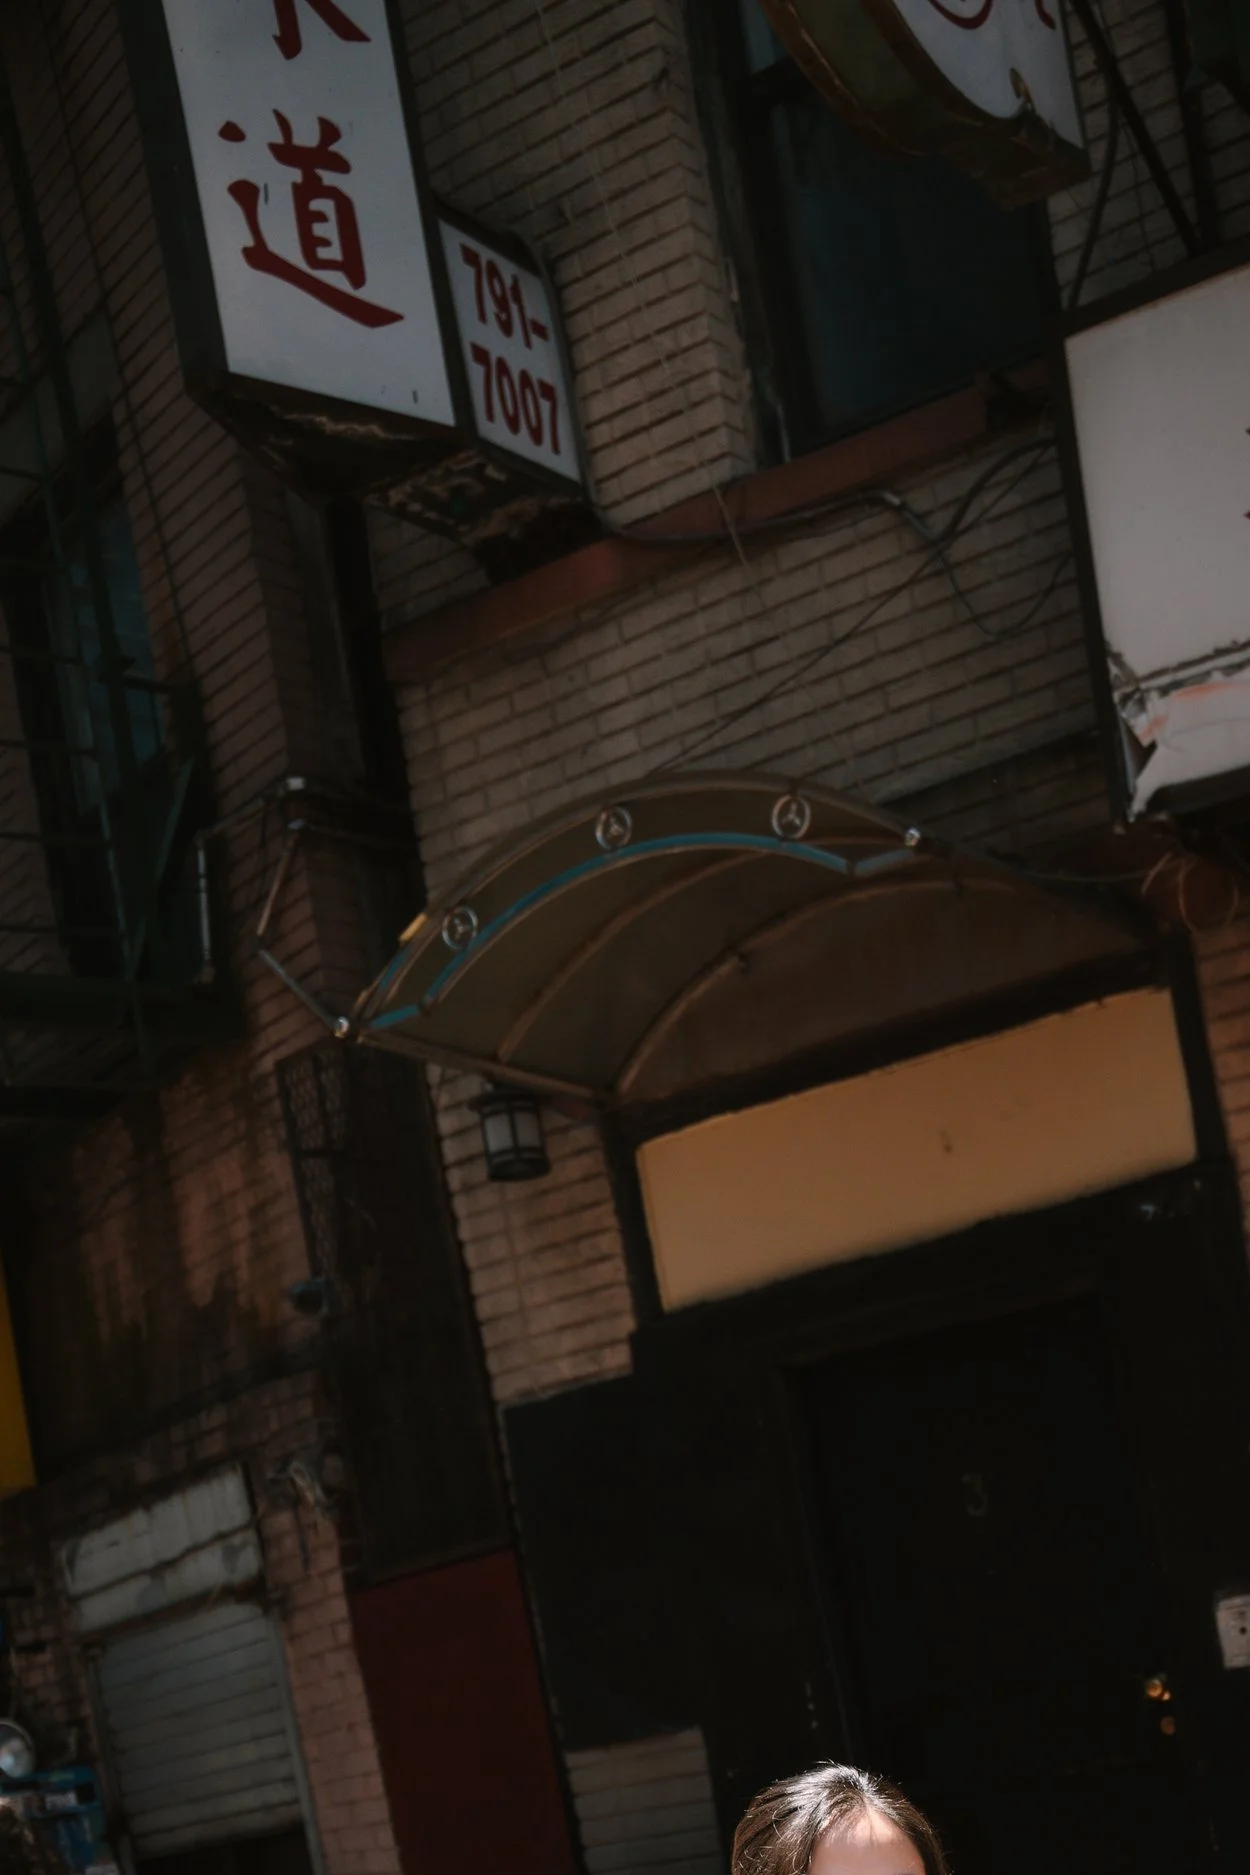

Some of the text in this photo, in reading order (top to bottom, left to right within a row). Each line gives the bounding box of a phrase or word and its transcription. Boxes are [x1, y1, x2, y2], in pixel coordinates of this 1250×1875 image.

[218, 0, 406, 328] 道
[459, 241, 551, 351] 791-
[471, 342, 563, 456] 7007
